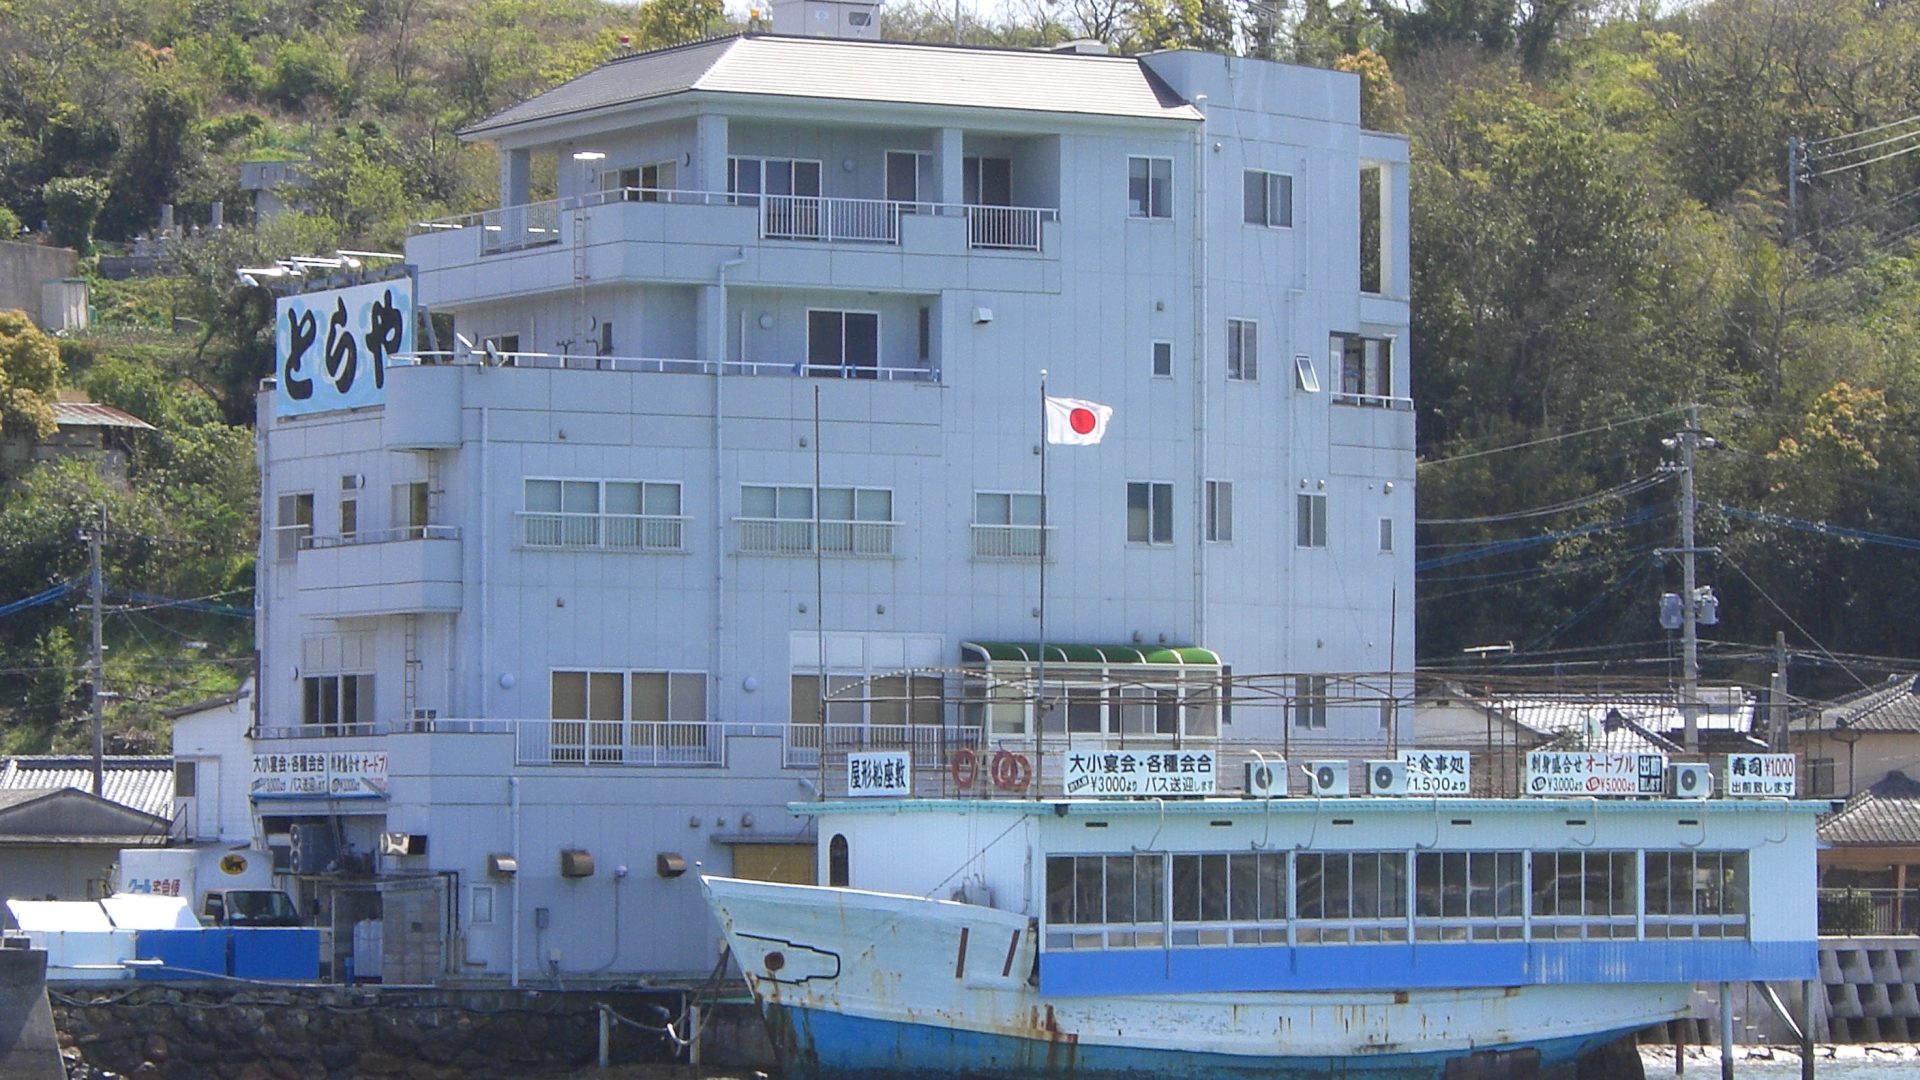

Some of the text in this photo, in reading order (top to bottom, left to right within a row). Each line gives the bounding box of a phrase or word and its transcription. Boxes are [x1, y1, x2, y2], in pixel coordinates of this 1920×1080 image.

[284, 289, 403, 400] とらや
[851, 758, 906, 789] 屋形船座敷
[1069, 753, 1212, 774] 大小宴会・各種会合
[1406, 753, 1465, 775] お食事処
[1585, 754, 1635, 774] オードブル
[1732, 756, 1762, 777] 寿司
[1145, 776, 1213, 793] バス送迎します
[1731, 781, 1793, 794] 出前致します
